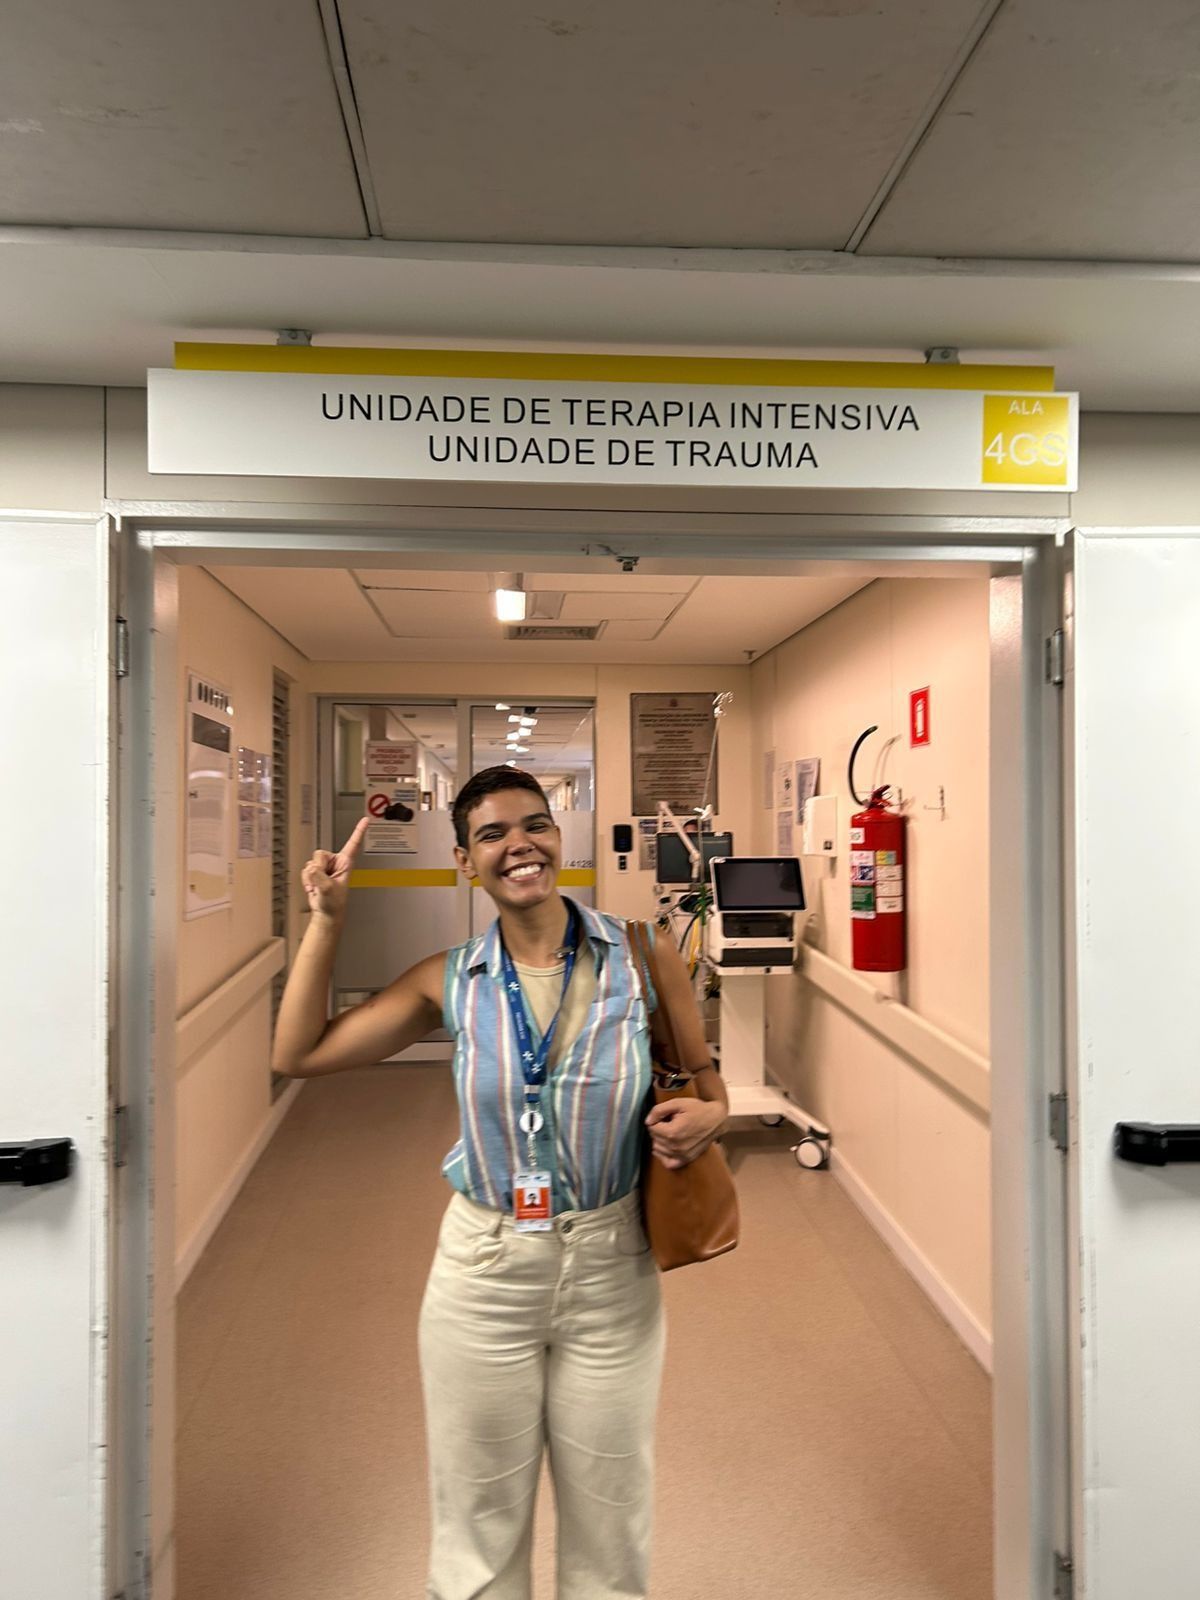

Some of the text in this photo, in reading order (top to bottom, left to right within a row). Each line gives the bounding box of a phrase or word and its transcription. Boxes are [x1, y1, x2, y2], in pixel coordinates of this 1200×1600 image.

[321, 392, 920, 431] UNIDADE DE TERAPIA INTENSIVA
[1008, 399, 1045, 415] ALA
[429, 435, 818, 468] UNIDADE DE TRAUMA
[984, 432, 1066, 467] 4GS
